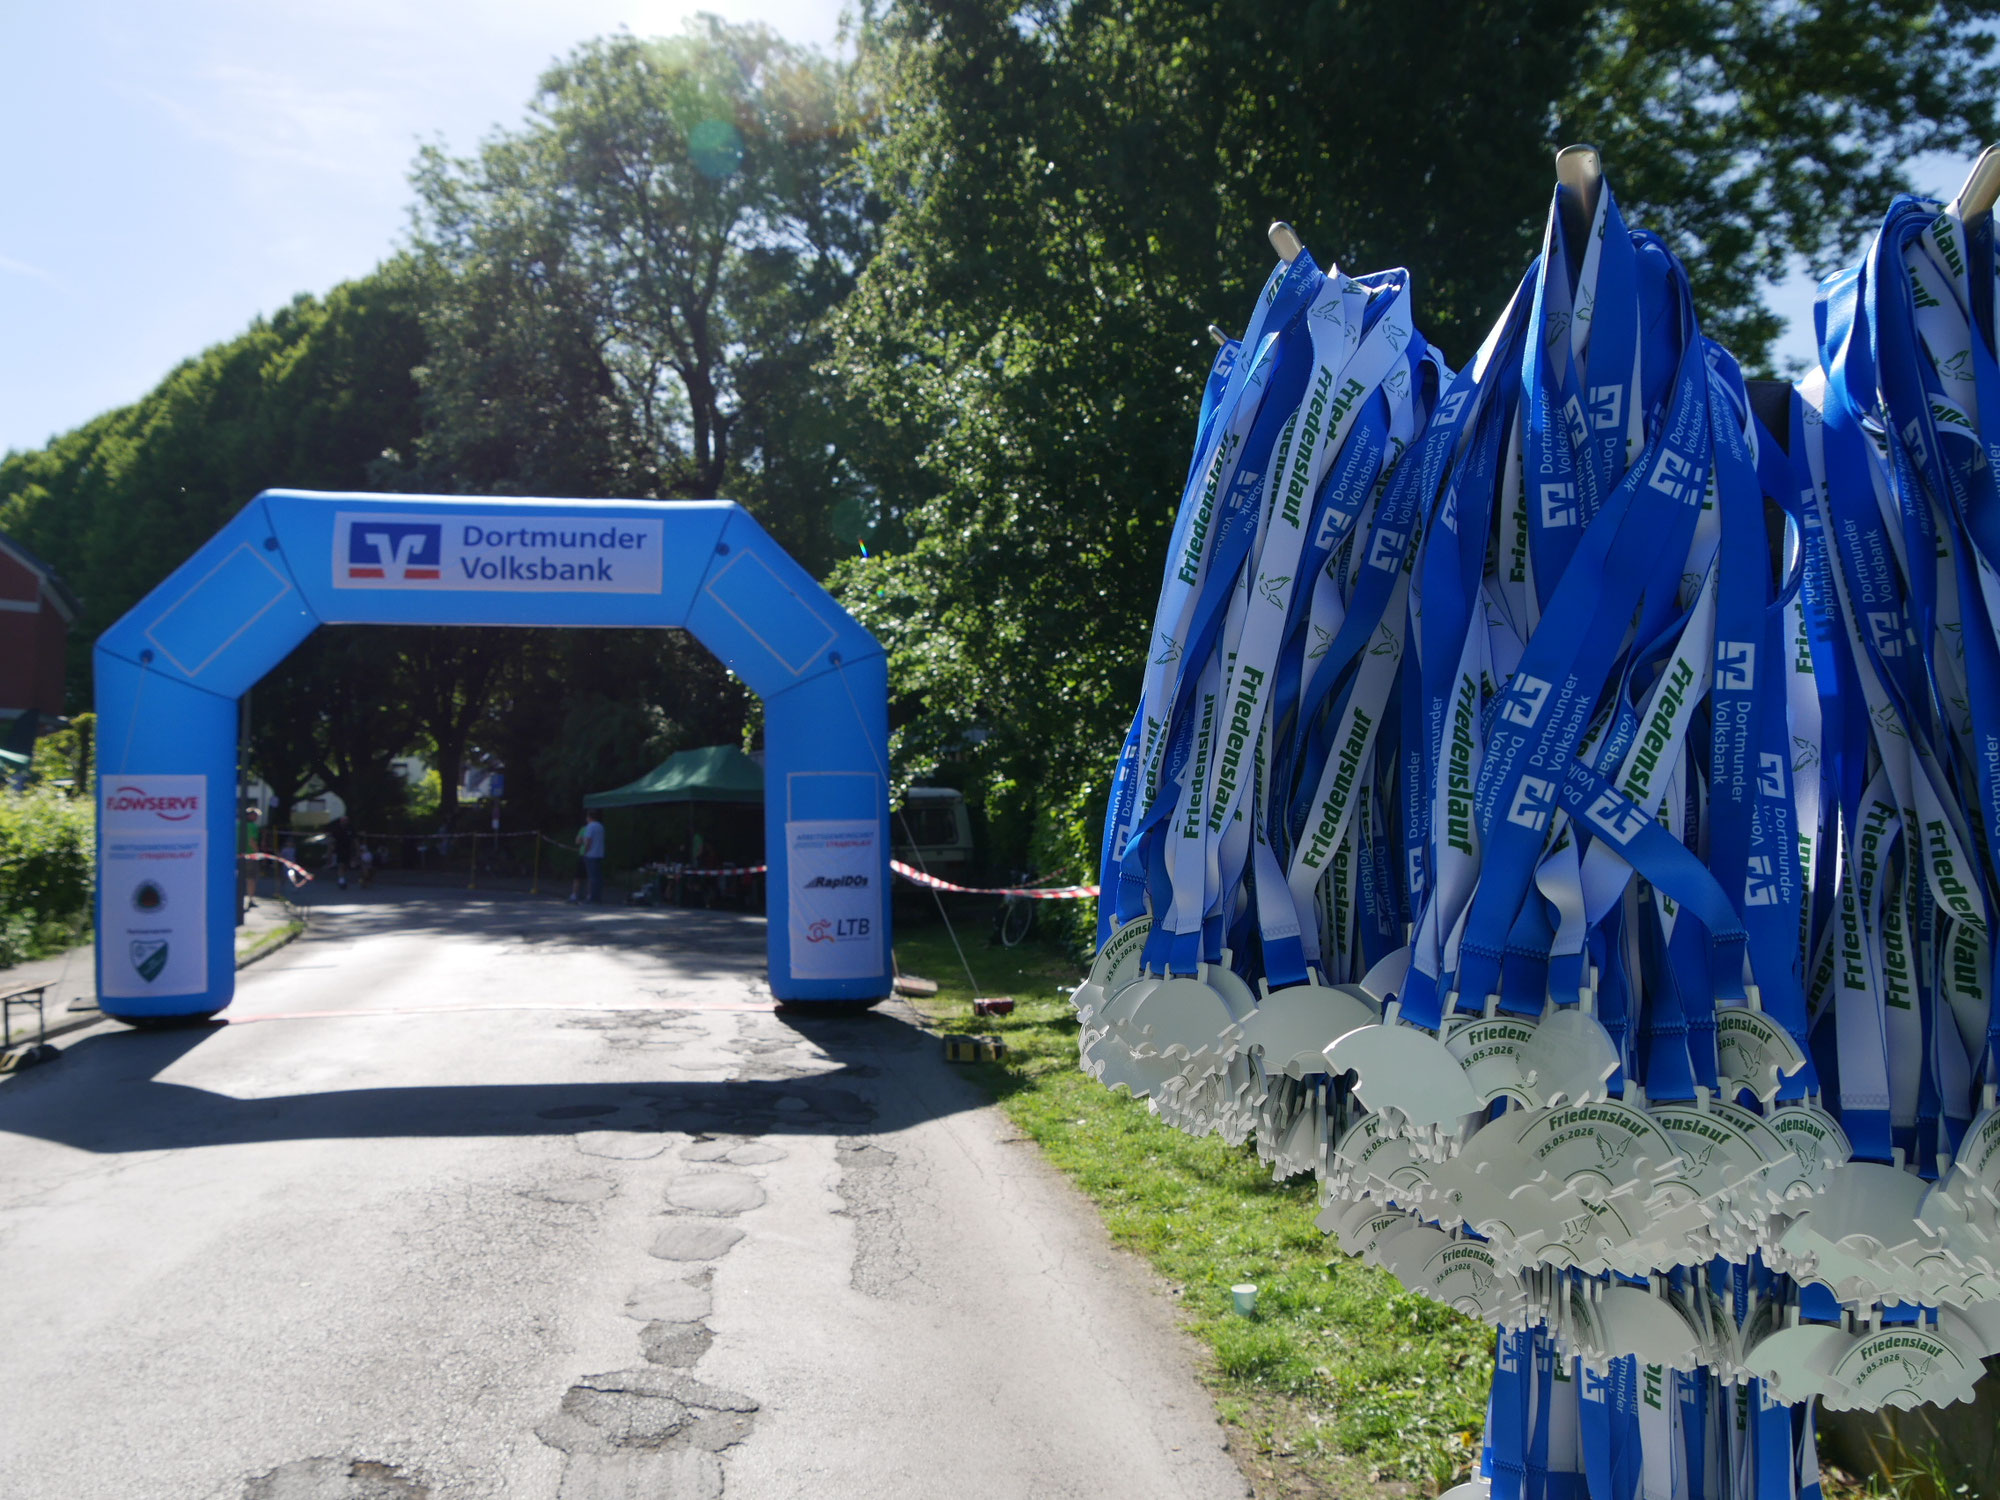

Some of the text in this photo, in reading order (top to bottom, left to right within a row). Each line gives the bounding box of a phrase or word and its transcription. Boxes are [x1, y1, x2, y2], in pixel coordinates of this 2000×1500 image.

[1282, 365, 1333, 529] Friedenslauf
[1540, 387, 1554, 475] Dortmunder
[1553, 407, 1572, 475] Volksbank
[1669, 376, 1695, 446] Dortmunder
[1684, 400, 1704, 455] Volksbank
[1332, 425, 1372, 501] Dortmunder
[1346, 445, 1381, 507] Volksbank
[1381, 457, 1413, 522] Dortmunder
[1397, 467, 1421, 525] Volksbank
[460, 556, 613, 582] Volksbank
[463, 525, 648, 550] Dortmunder
[1843, 518, 1876, 603] Dortmunder
[1864, 528, 1894, 604] Volksbank
[1208, 665, 1265, 834] Friedenslauf
[1529, 673, 1579, 767] Dortmunder
[1547, 695, 1591, 771] Volksbank
[1620, 657, 1694, 805] Friedensl
[1713, 700, 1731, 784] Volksbank
[1731, 701, 1751, 803] Dortmunder
[1183, 694, 1215, 839] Friedenslauf
[1302, 707, 1372, 869] Friedenslauf
[1408, 751, 1421, 839] Dortmunder
[1448, 672, 1476, 856] Friedenslauf
[1475, 731, 1509, 812] Volksbank
[1482, 735, 1525, 836] Dortmunder
[1775, 807, 1795, 904] Dortmunder
[837, 917, 870, 937] LTB
[1105, 921, 1151, 960] Friedensl
[1106, 943, 1137, 981] 25.05.2026
[1460, 1046, 1513, 1070] 25.05.2026
[1539, 1128, 1594, 1157] 25.05.2026
[1549, 1107, 1650, 1138] Friedenslauf
[1436, 1263, 1471, 1284] 25.05.2026
[1856, 1353, 1900, 1385] 25.05.2026
[1860, 1337, 1944, 1361] Friedenslauf
